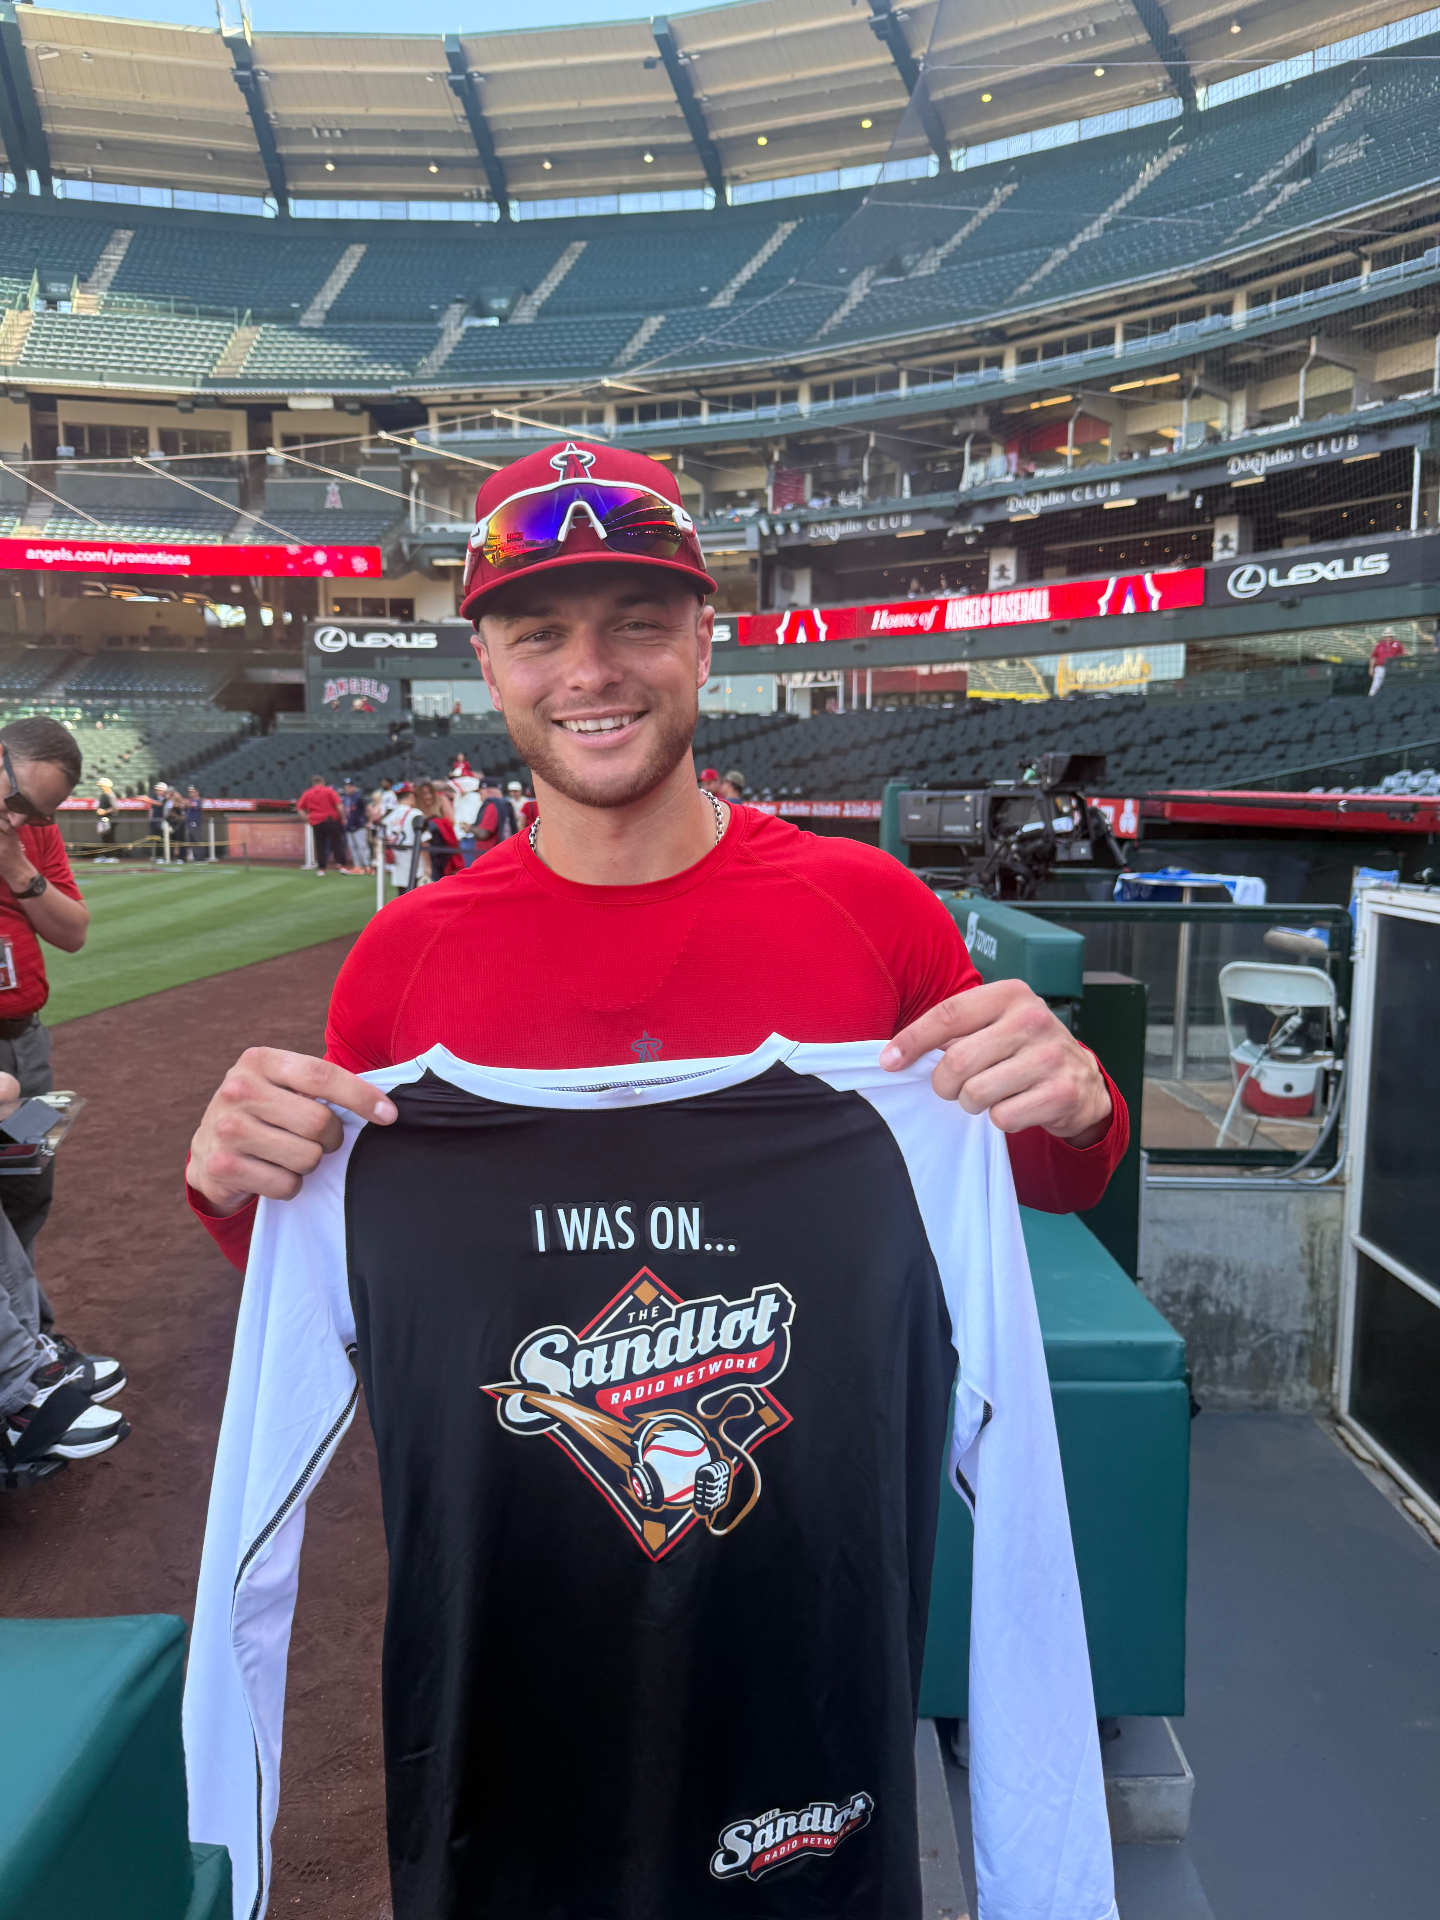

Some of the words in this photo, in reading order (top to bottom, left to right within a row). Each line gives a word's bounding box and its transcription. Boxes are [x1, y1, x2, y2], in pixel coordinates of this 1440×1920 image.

[1302, 434, 1359, 460] CLUB
[1071, 481, 1121, 502] CLUB
[867, 514, 912, 532] CLUB
[25, 547, 191, 565] angels.com/promotions
[1268, 553, 1390, 587] LEXUS
[871, 609, 919, 631] Home
[918, 605, 940, 631] of
[944, 595, 991, 630] ANGELS
[991, 588, 1051, 625] BASEBALL
[348, 632, 438, 648] LEXUS
[322, 676, 390, 704] ANGELS
[975, 929, 998, 961] TOYOTA
[536, 1210, 546, 1252] I
[558, 1206, 635, 1252] WAS
[650, 1206, 736, 1252] ON...
[628, 1305, 660, 1324] THE
[505, 1293, 782, 1422] Sandlot
[611, 1379, 665, 1405] RADIO
[674, 1356, 758, 1388] NETWORK
[758, 1810, 777, 1824] THE
[714, 1798, 866, 1873] Sandlot
[764, 1840, 797, 1862] RADIO
